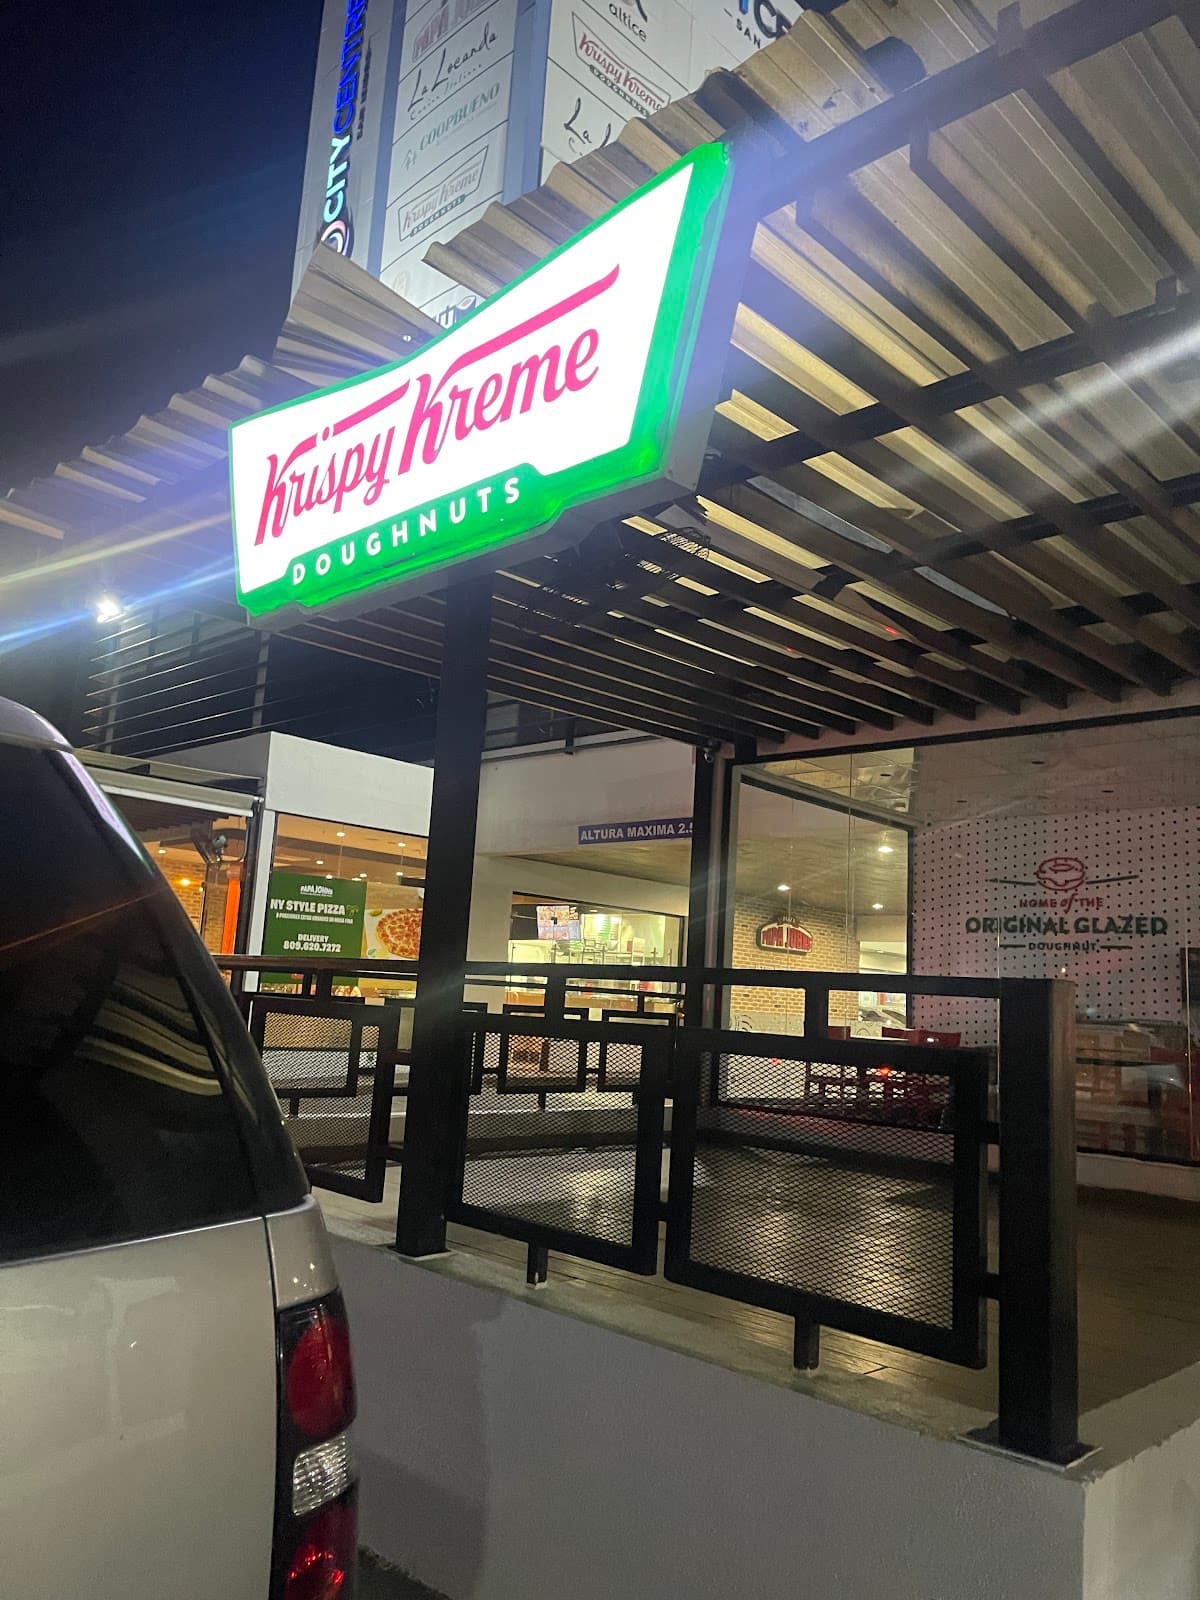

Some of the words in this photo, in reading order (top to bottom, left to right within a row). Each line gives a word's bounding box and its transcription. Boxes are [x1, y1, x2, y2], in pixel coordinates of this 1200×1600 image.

[608, 3, 647, 42] altice
[407, 68, 429, 112] La
[254, 379, 410, 547] Krispy
[397, 264, 620, 476] Kreme
[291, 476, 521, 586] DOUGHNUTS
[580, 827, 625, 841] ALTURA
[627, 823, 675, 838] MAXIMA
[270, 898, 285, 910] NY
[286, 900, 316, 913] STYLE
[316, 902, 346, 916] PIZZA
[1019, 898, 1058, 909] HOME
[1079, 896, 1104, 909] THE
[964, 915, 1071, 934] ORIGINAL
[1073, 914, 1169, 935] GLAZED
[297, 933, 330, 943] DELIVERY
[1027, 941, 1098, 951] DOUGHNUT
